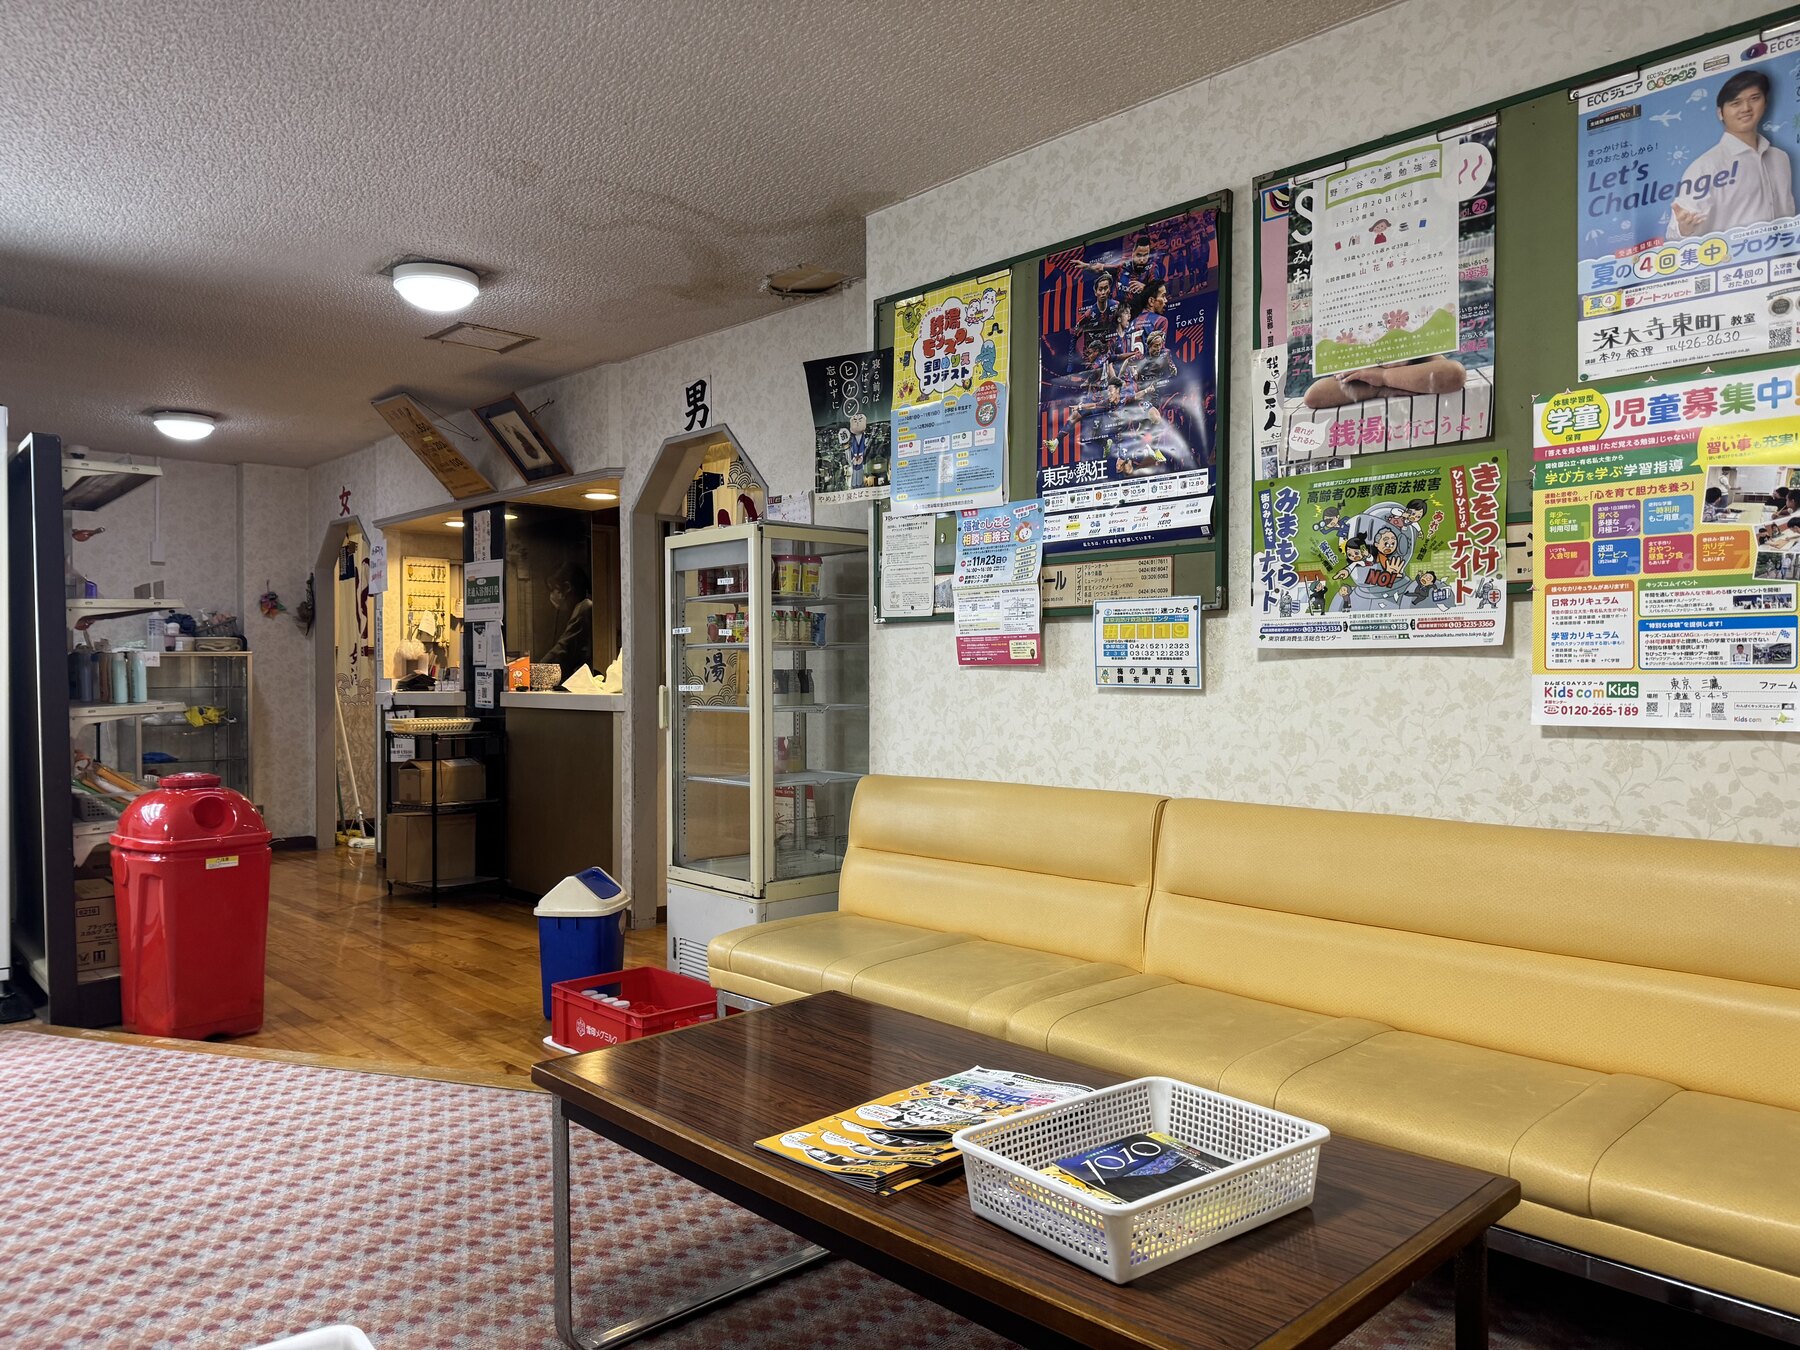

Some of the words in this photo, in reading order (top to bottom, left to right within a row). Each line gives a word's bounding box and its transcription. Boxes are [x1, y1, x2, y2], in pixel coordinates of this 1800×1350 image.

[1587, 81, 1643, 107] ECCジュニア
[1588, 141, 1633, 157] きっかけは、
[1588, 160, 1649, 193] Let's
[1588, 161, 1738, 217] Challenge!
[1474, 200, 1486, 211] 26
[1722, 268, 1763, 282] 全4回の
[1728, 279, 1757, 288] おためし
[1625, 290, 1691, 307] 夢ノートプレゼント
[930, 307, 961, 337] 銭湯
[1176, 316, 1204, 328] TOKYO
[1731, 313, 1756, 326] 教室
[1592, 313, 1726, 352] 深大寺東町
[1677, 331, 1740, 351] 426-8630
[923, 328, 974, 358] モンスター
[924, 353, 970, 373] 全国ぬりえ
[861, 361, 869, 404] たばこの
[872, 358, 880, 402] 寝る前は
[924, 368, 970, 386] コンテスト
[826, 366, 840, 409] 忘れずに
[842, 363, 859, 415] ヒケシ
[684, 379, 709, 431] 男
[1554, 394, 1594, 406] 体験学習型
[1546, 404, 1601, 434] 学童
[1294, 426, 1314, 435] 疲れが
[1042, 459, 1109, 488] 東京が熱狂
[1545, 458, 1684, 485] 学び方を学ぶ学習指導
[1307, 478, 1441, 503] 高齢者の悪質商法被害
[1452, 470, 1467, 528] ひとりひとりが
[1590, 481, 1695, 500] 「心を育て胆力を養う」
[339, 486, 351, 516] 女
[964, 517, 1011, 531] 福祉のしごと
[1468, 462, 1500, 576] きをつけ
[1598, 511, 1620, 520] 選べる
[1598, 518, 1620, 527] 多様な
[1649, 513, 1679, 522] もご用意
[1679, 514, 1692, 532] 3
[1549, 524, 1578, 533] 利用可能
[1581, 522, 1588, 539] 1
[1598, 524, 1633, 534] 月極コース
[1625, 517, 1640, 536] 2
[963, 530, 1011, 546] 相談・面接会
[1274, 487, 1300, 588] みまもら
[1550, 551, 1578, 559] 入会可能
[1598, 544, 1614, 552] 送迎
[1598, 551, 1628, 559] サービス
[1648, 550, 1683, 560] 昼食・夕食
[1626, 557, 1640, 574] 5
[1678, 554, 1692, 571] 6
[1734, 550, 1749, 568] 7
[1448, 532, 1473, 605] ナイト
[1574, 560, 1588, 576] 4
[1259, 549, 1277, 613] ナイト
[1365, 569, 1395, 588] NO!
[1551, 597, 1619, 607] 日常カリキュラム
[1104, 624, 1188, 638] #7119
[1551, 631, 1619, 640] 学習カリキュラム
[704, 652, 726, 684] 湯
[1117, 676, 1190, 684] 調布消防署
[1670, 677, 1691, 690] 東京
[1760, 681, 1797, 690] ファーム
[1544, 686, 1573, 698] Kids
[1576, 689, 1604, 698] com
[1608, 683, 1637, 696] Kids
[1695, 691, 1728, 699] 8-4-5
[1561, 705, 1639, 716] 0120-265-189
[1081, 1142, 1161, 1185] 1010
